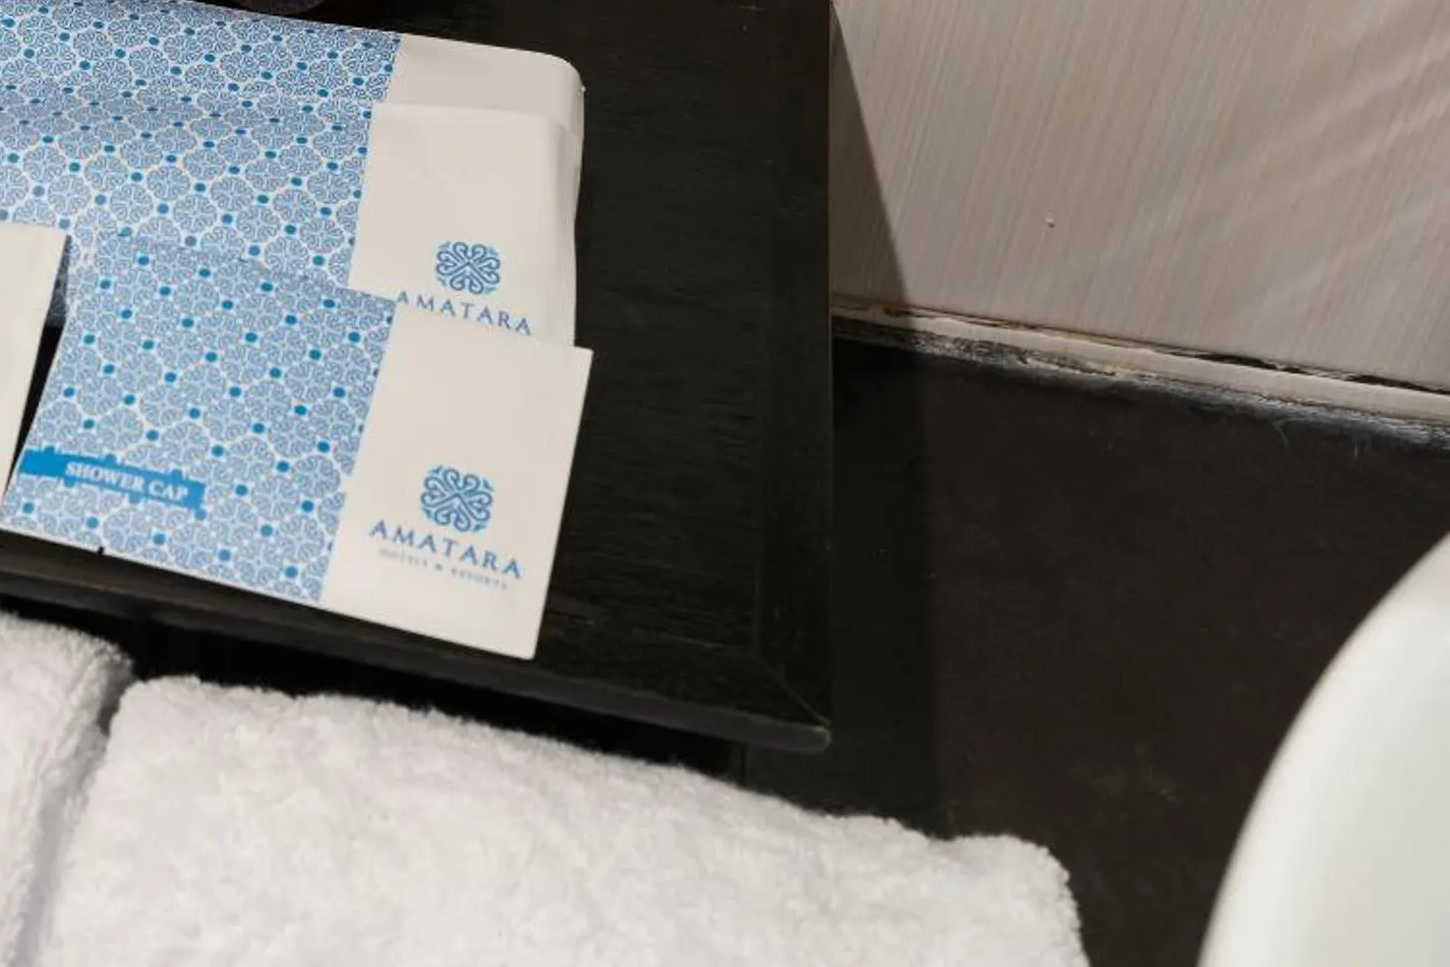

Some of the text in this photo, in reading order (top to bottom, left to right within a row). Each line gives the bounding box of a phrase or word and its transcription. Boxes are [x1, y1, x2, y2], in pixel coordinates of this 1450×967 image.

[396, 291, 531, 336] AMATARA
[66, 463, 189, 500] SHOWER CAP
[368, 519, 521, 580] AMATARA
